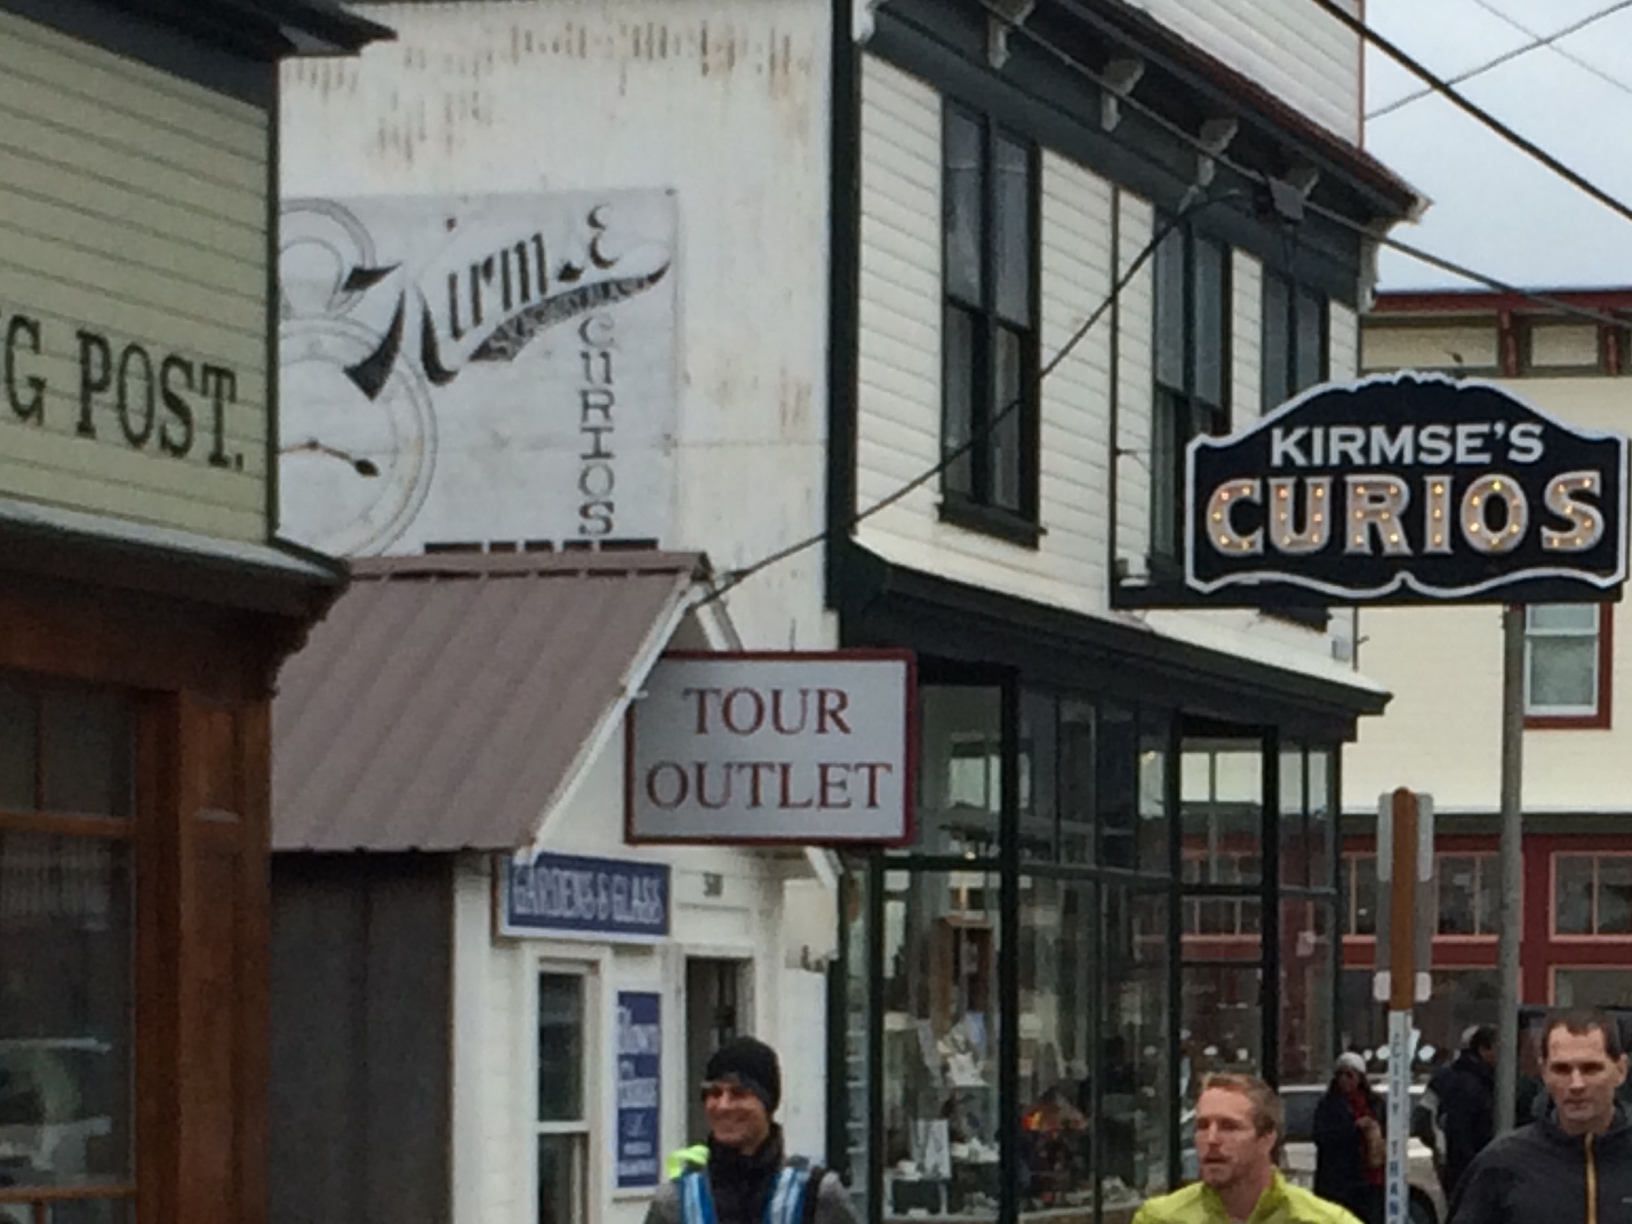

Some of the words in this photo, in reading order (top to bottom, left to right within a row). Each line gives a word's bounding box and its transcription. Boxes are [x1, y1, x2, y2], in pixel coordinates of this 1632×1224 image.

[76, 328, 243, 471] POST.
[576, 313, 616, 534] CURIOS
[1270, 422, 1545, 468] KIRMSE'S
[1206, 470, 1604, 556] CURIOS
[684, 687, 852, 737] TOUR
[646, 761, 893, 810] OUTLET
